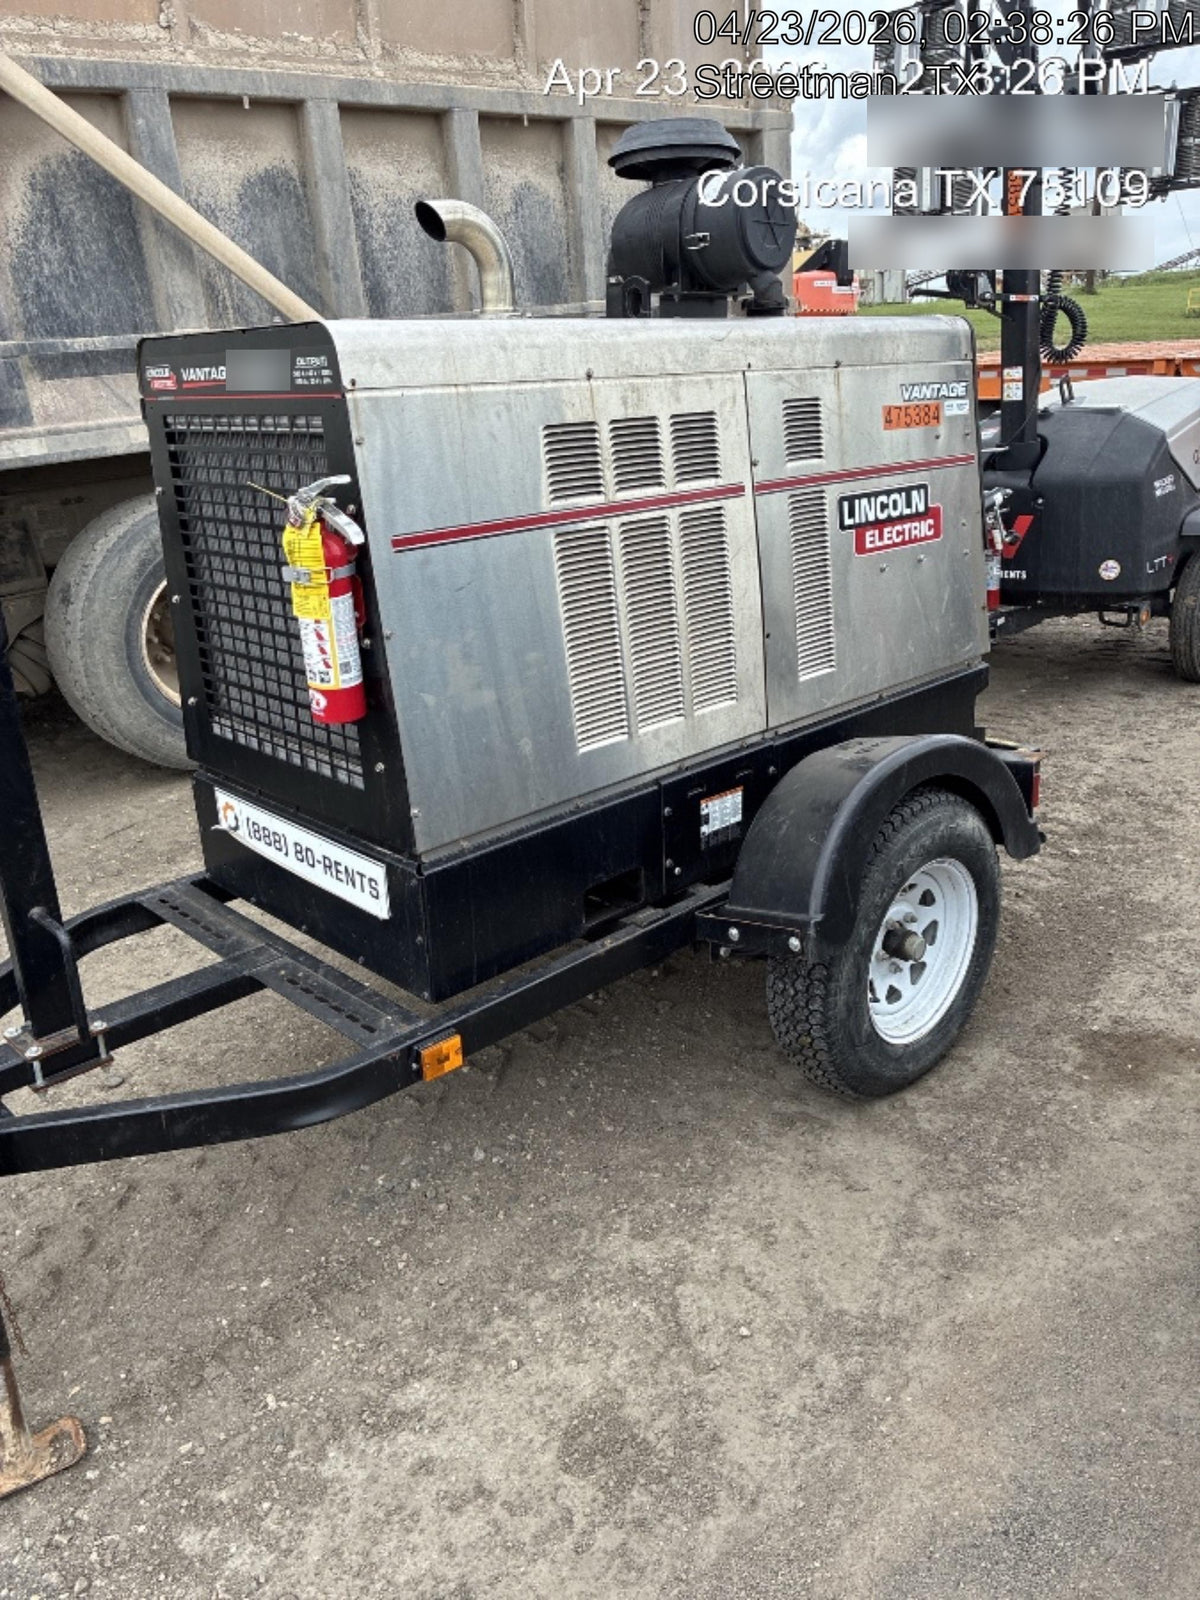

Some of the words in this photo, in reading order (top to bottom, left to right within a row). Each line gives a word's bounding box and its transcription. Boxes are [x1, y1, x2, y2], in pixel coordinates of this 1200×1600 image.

[181, 366, 227, 381] VANTAG
[901, 381, 968, 401] VANTAGE
[884, 404, 941, 427] 475384
[843, 488, 926, 526] LINCOLN
[865, 518, 935, 549] ELECTRIC
[246, 816, 289, 857] (888)
[293, 842, 380, 900] 80-RENTS
